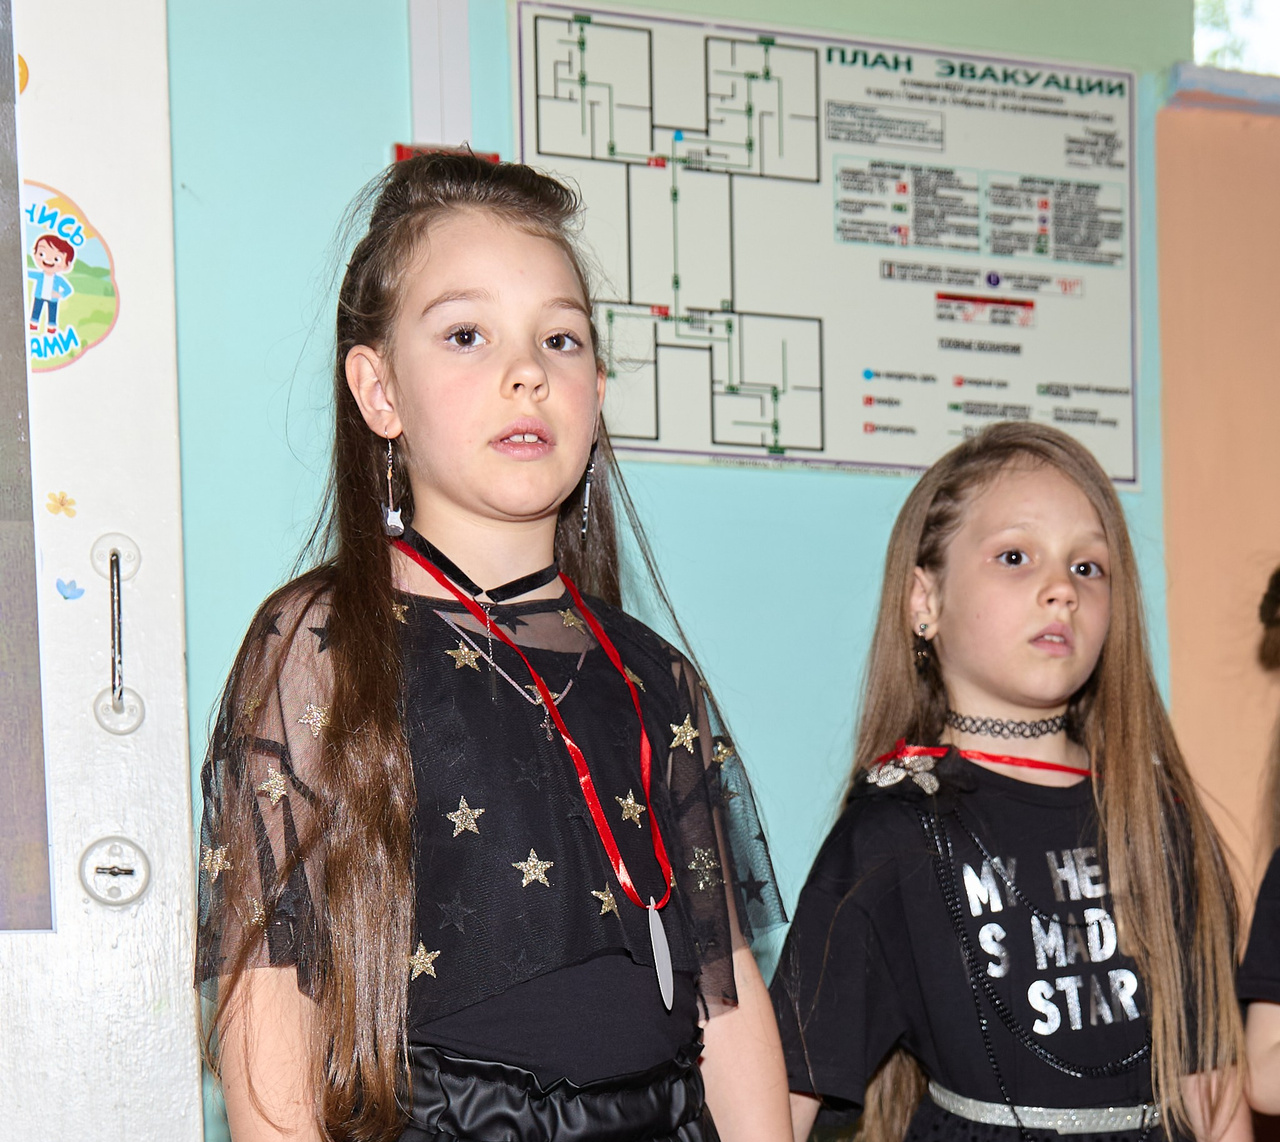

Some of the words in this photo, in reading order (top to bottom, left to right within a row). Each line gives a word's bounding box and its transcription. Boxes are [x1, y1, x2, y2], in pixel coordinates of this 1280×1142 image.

[826, 47, 912, 73] ПЛАН
[936, 59, 1126, 98] ЭВАКУАЦИИ
[962, 855, 1017, 917] MY
[966, 922, 1010, 980] S
